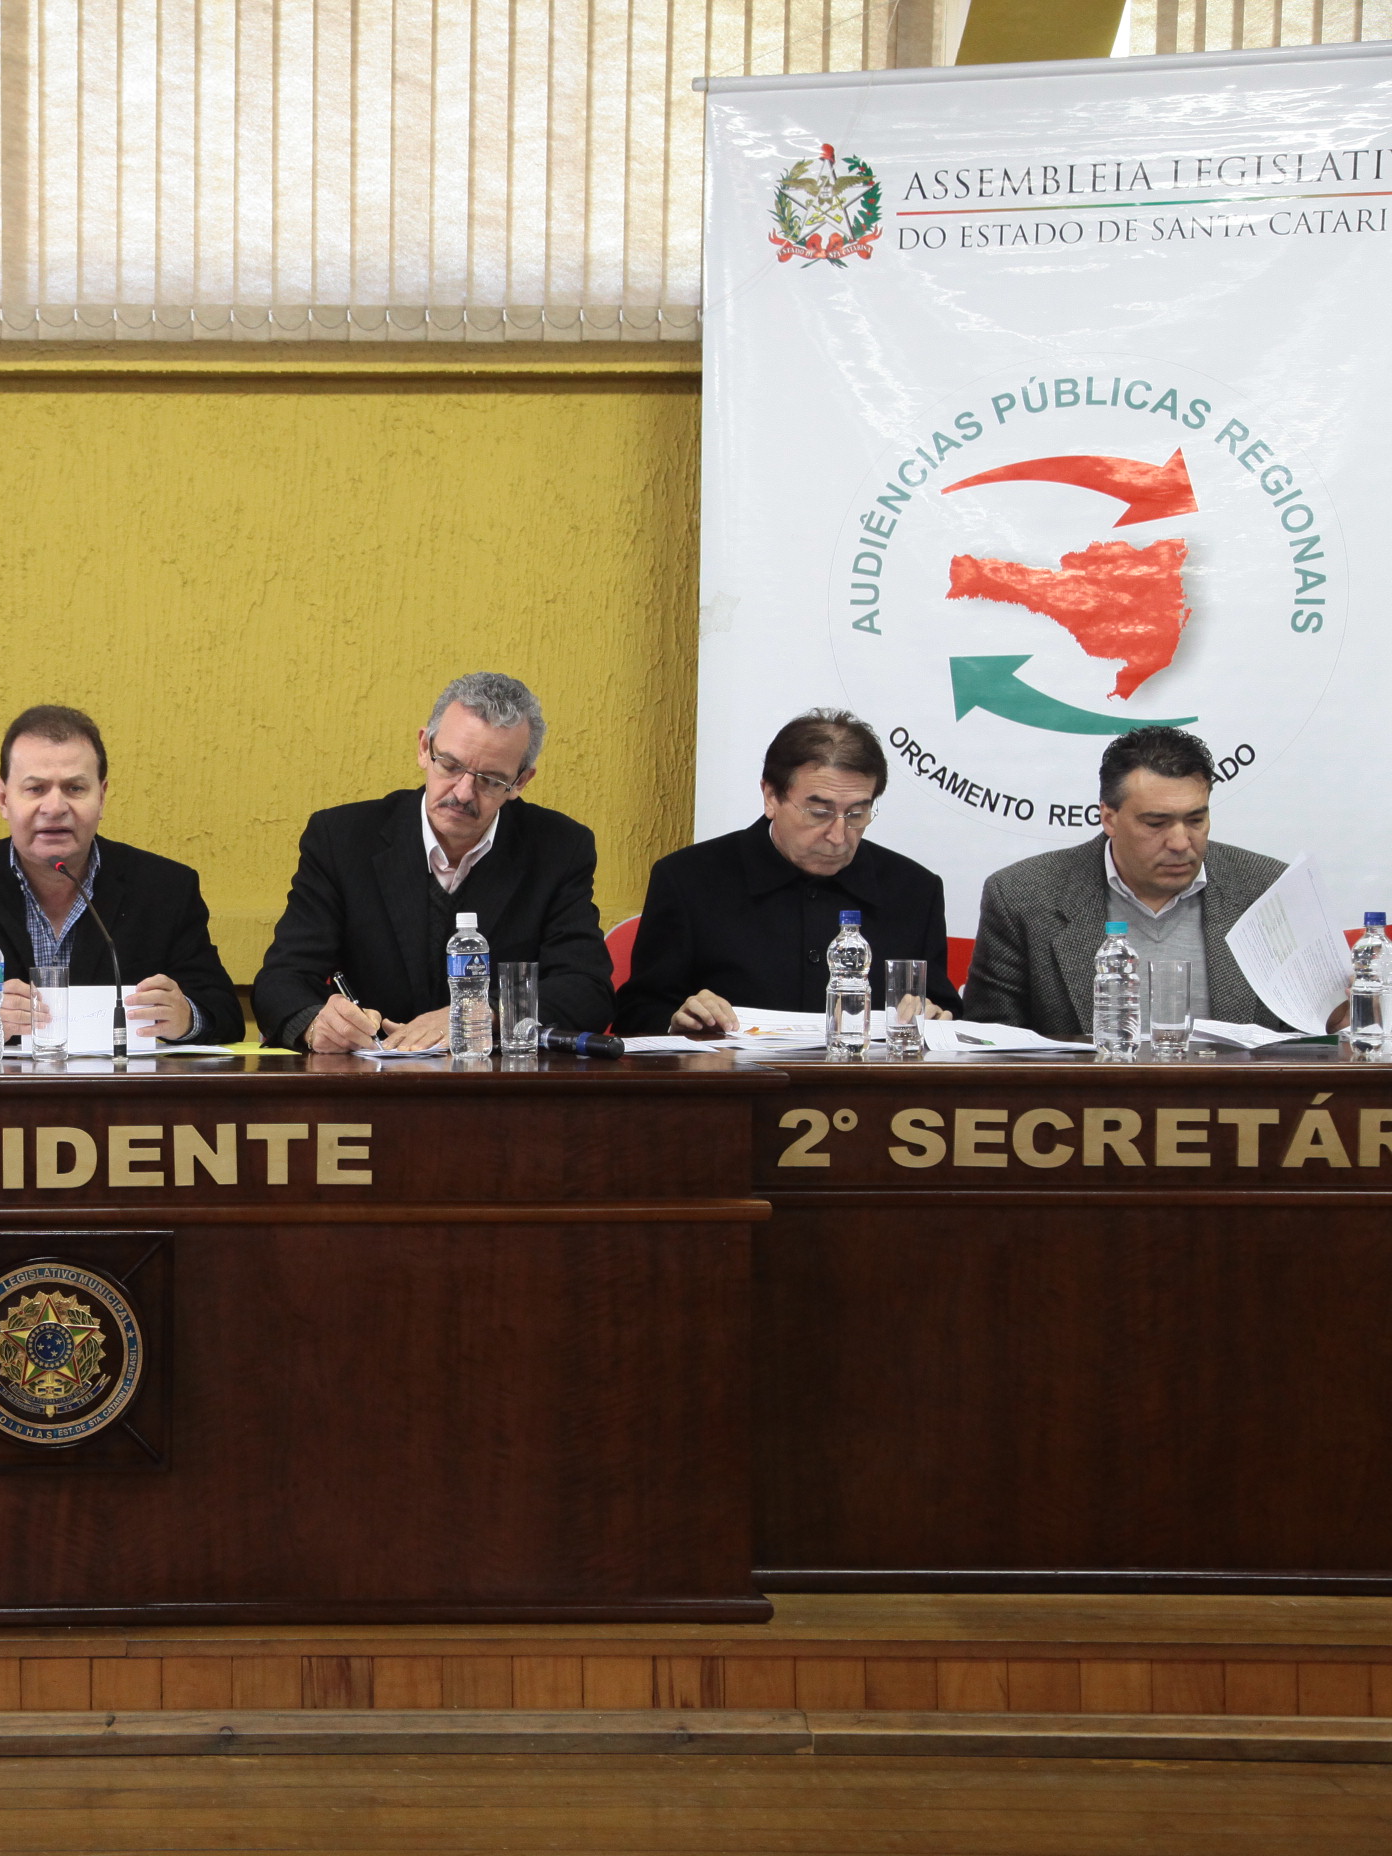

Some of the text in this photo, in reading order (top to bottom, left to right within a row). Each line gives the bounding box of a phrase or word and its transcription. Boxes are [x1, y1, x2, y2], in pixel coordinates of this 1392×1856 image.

[902, 148, 1392, 201] ASSEMBLEIA LEGISLATI
[898, 226, 947, 251] DO
[960, 220, 1084, 249] ESTADO
[1098, 219, 1138, 244] DE
[1152, 213, 1258, 241] SANTA
[851, 376, 1327, 636] AUDIÊNCIAS PÚBLICAS REGIONAIS
[889, 726, 1035, 822] ORÇAMENTO
[1048, 803, 1101, 828] REG
[2, 1268, 77, 1290] LEGISLATIVO
[78, 1274, 131, 1328] MUNICIPAL
[75, 1424, 87, 1433] DE
[126, 1345, 137, 1380] BRASIL
